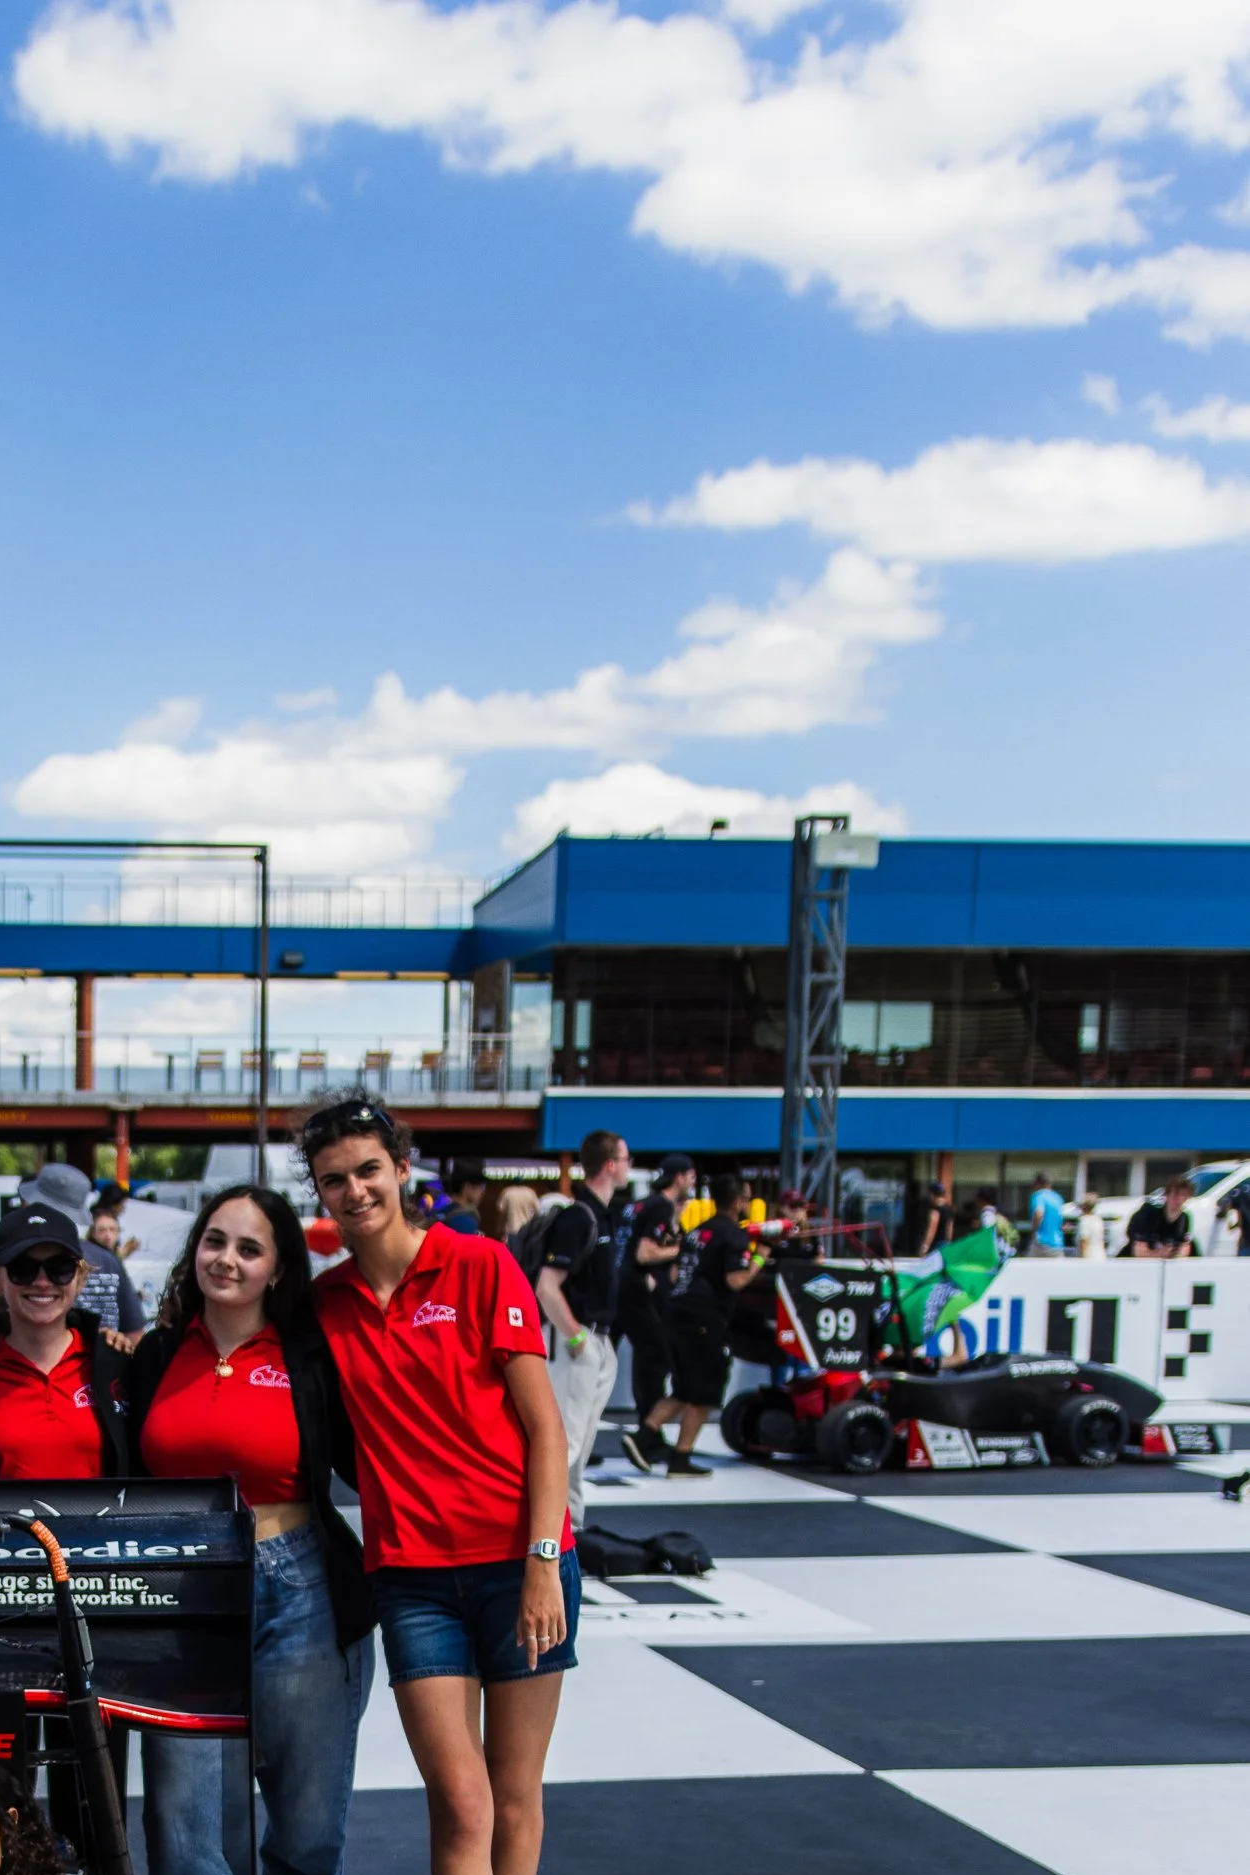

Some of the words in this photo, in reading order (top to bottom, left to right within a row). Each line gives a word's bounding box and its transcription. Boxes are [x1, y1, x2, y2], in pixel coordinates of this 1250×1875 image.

[816, 1308, 857, 1341] 99
[36, 1574, 104, 1590] sion
[109, 1574, 149, 1590] inc.
[72, 1591, 134, 1605] works
[140, 1590, 179, 1605] inc.
